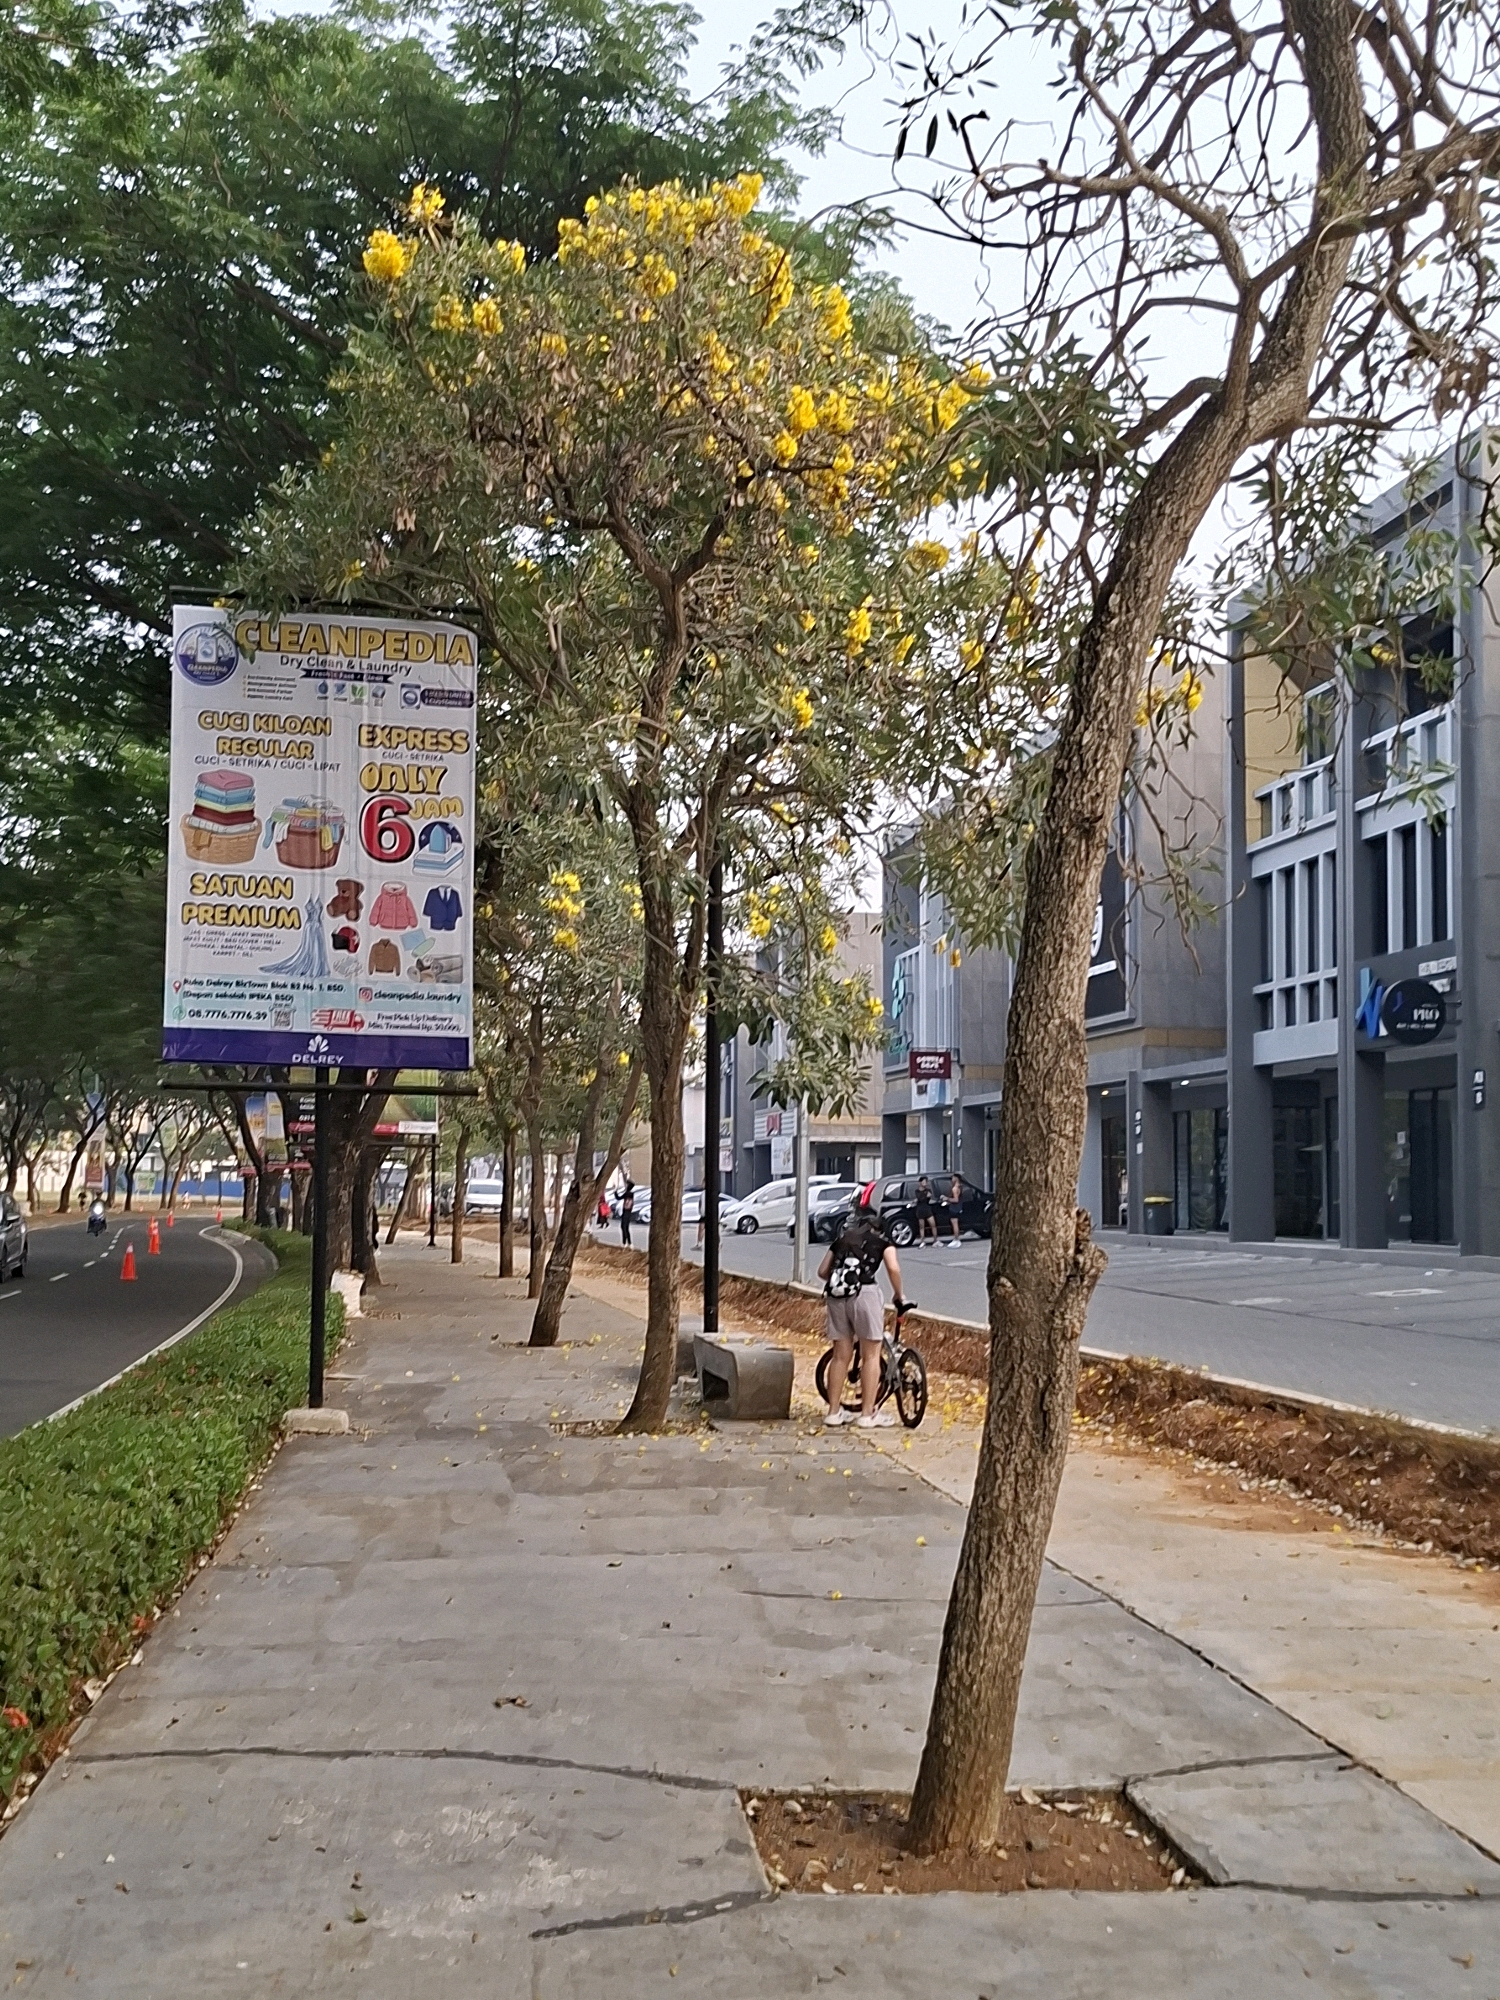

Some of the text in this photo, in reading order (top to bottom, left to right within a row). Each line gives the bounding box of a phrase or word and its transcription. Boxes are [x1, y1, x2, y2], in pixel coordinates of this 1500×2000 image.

[235, 618, 474, 666] CLEANPEDIA
[280, 654, 412, 676] Dry Clean & Laundry
[198, 710, 332, 736] CUCI KILOAN
[216, 736, 315, 760] REGULAR
[358, 723, 470, 754] EXPRESS
[194, 755, 220, 765] CUCI
[228, 757, 271, 769] SETRIKA
[280, 759, 306, 770] CUCI
[314, 761, 341, 773] LIPAT
[382, 751, 403, 760] CUCI
[410, 753, 444, 762] SETRIKA
[359, 793, 464, 863] 6 JAM
[190, 872, 294, 899] SATUAN
[182, 902, 302, 929] PREMIUM
[206, 979, 233, 988] Delrey
[270, 981, 287, 989] Blok
[214, 991, 246, 1000] sekolah
[374, 989, 462, 1004] cleanpedia.laundry
[292, 1053, 345, 1065] DELREY
